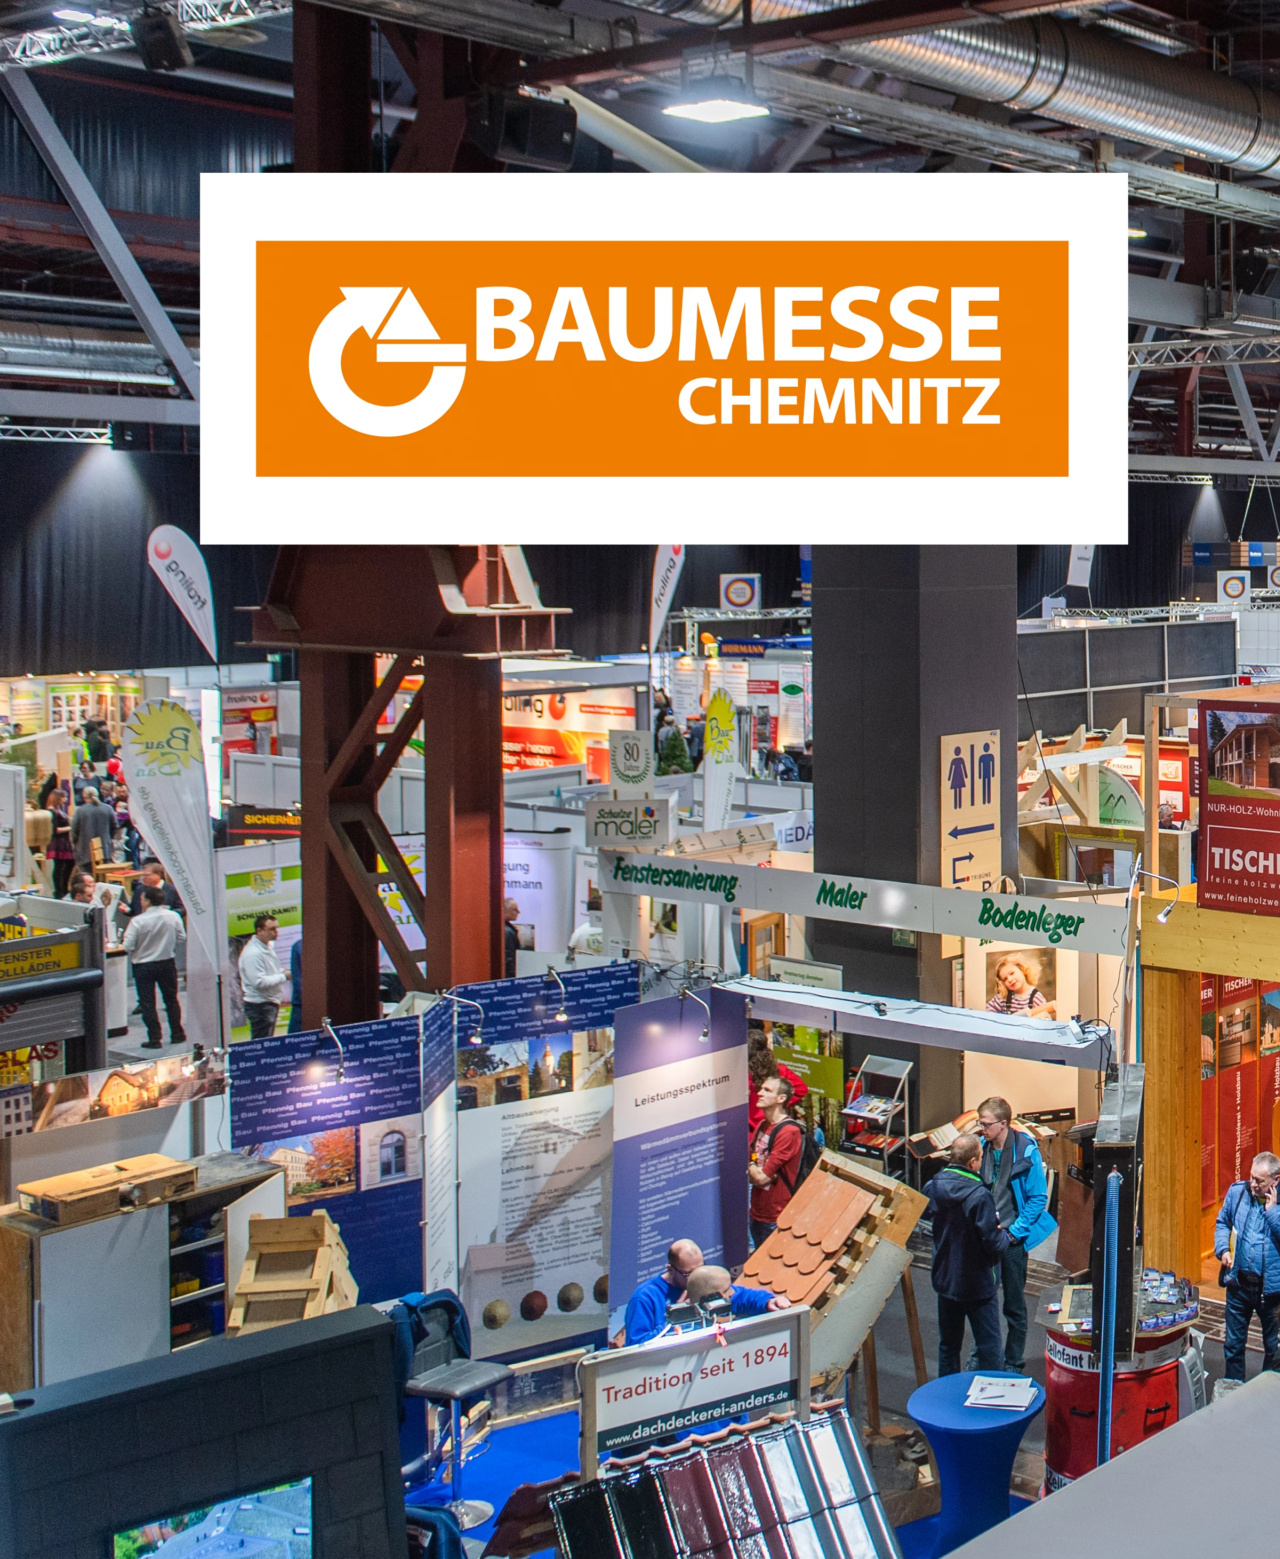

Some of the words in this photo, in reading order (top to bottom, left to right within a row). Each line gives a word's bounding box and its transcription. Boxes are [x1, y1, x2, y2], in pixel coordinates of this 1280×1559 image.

[709, 717, 730, 741] Bau
[624, 742, 639, 762] 80
[624, 762, 640, 771] Jahre
[594, 807, 660, 836] maler
[596, 808, 632, 819] Schulze
[612, 856, 739, 902] Fenstersanierung
[971, 872, 991, 880] TRIBÜNE
[1211, 875, 1239, 886] feine
[816, 878, 868, 911] Maler
[978, 898, 1085, 944] Bodenleger
[339, 1025, 370, 1035] Pfennig
[231, 1042, 262, 1052] Pfennig
[264, 1039, 281, 1047] Bau
[285, 1034, 317, 1044] Pfennig
[368, 1037, 398, 1047] Pfennig
[401, 1034, 416, 1042] Bau
[261, 1055, 293, 1065] Pfennig
[255, 1072, 287, 1082] Pfennig
[289, 1068, 306, 1076] Bau
[634, 1074, 730, 1107] Leistungsspektrum
[501, 1106, 559, 1120] Altbausanierung
[501, 1164, 534, 1175] Lehmbau
[602, 1370, 693, 1404] Tradition
[700, 1358, 735, 1380] seit
[742, 1342, 789, 1368] 1894
[606, 1391, 788, 1447] www.dachdeckerei-anders.de
